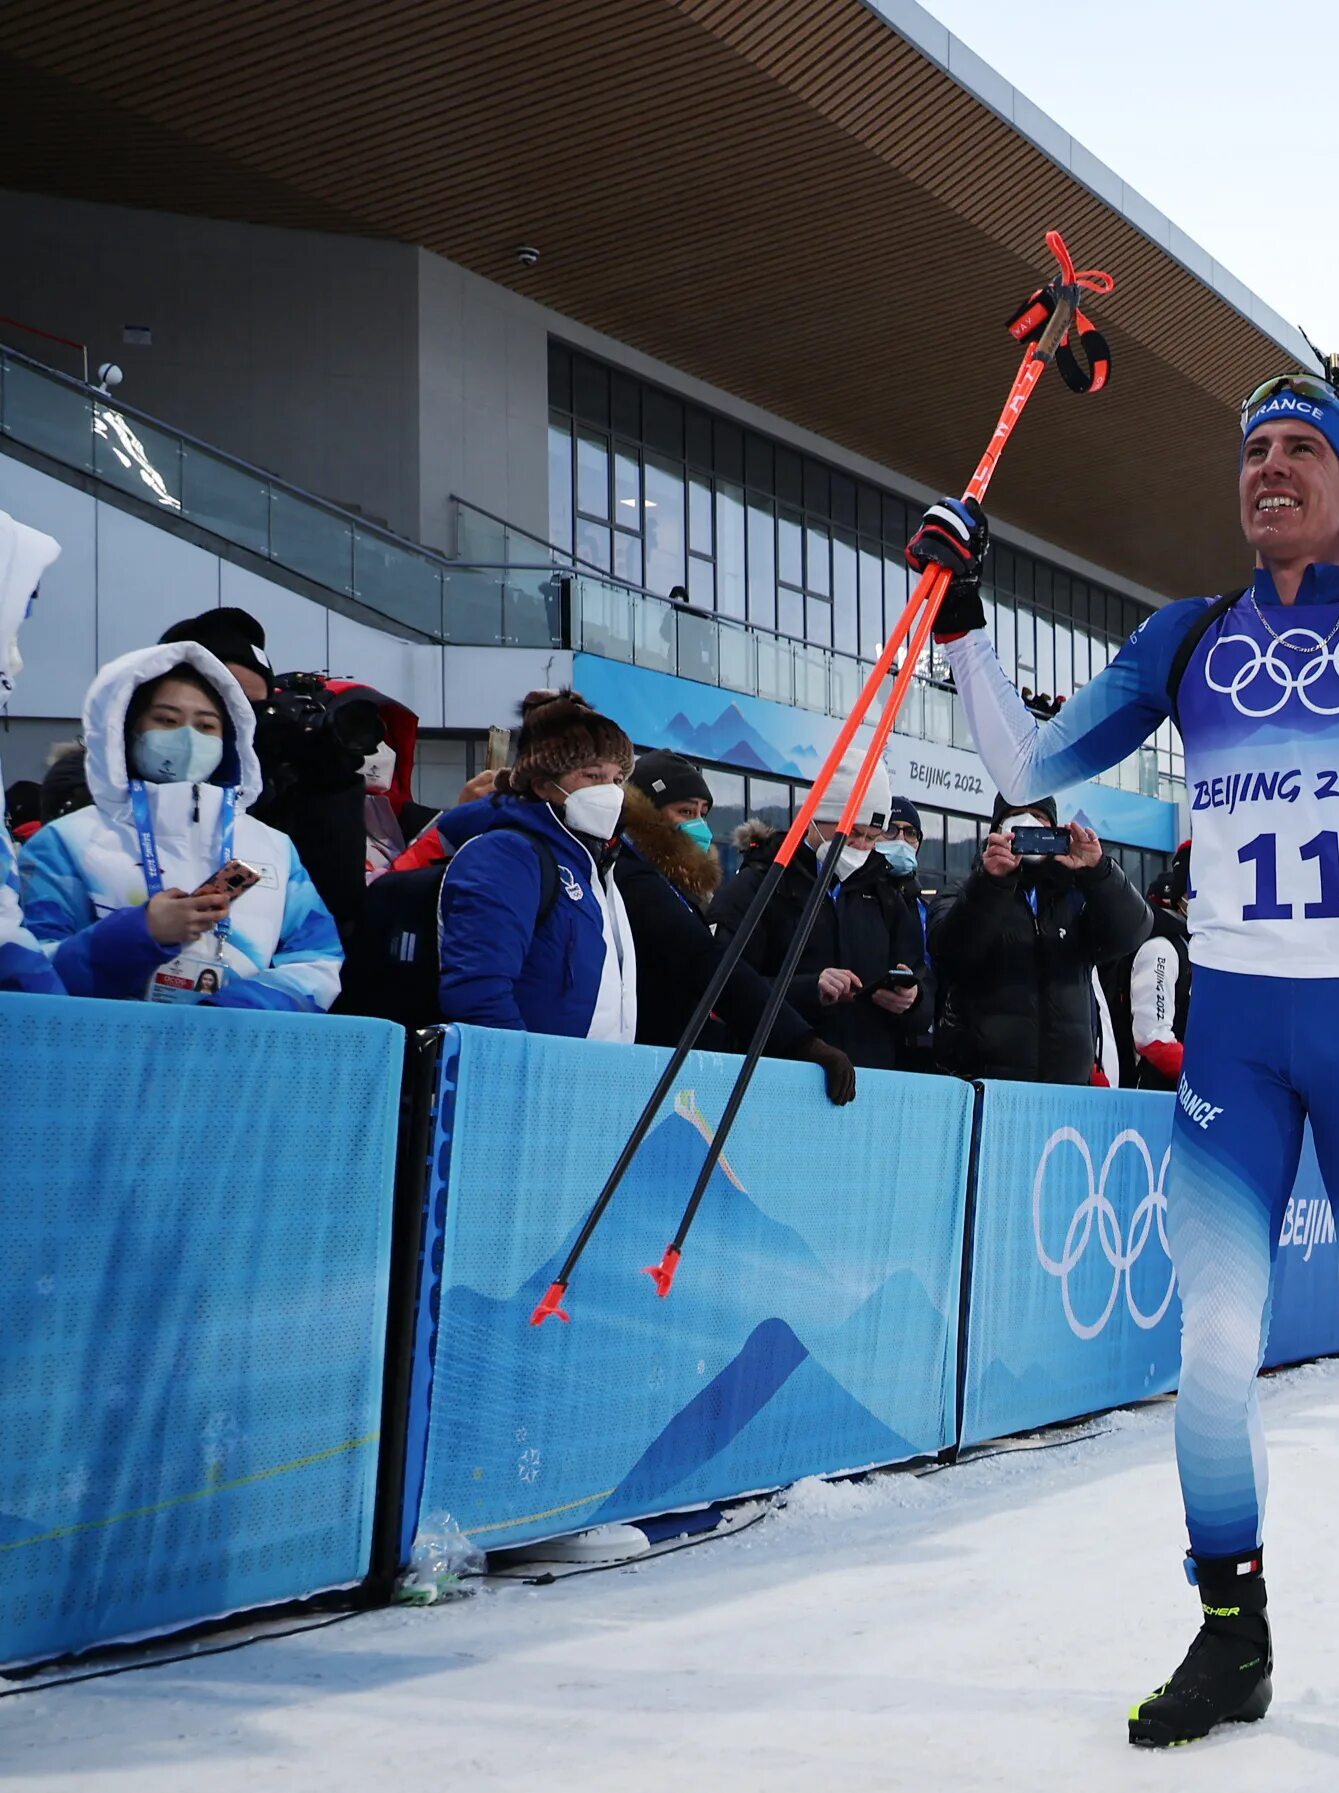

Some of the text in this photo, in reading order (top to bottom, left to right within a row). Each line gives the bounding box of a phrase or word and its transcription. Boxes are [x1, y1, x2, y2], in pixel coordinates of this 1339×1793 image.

[909, 760, 984, 794] BEIJING 2022
[1192, 769, 1302, 814] BEIJING
[1154, 956, 1166, 1021] BEIJING 2022
[1178, 1070, 1224, 1130] FRANCE
[1278, 1197, 1338, 1263] BEIJIN
